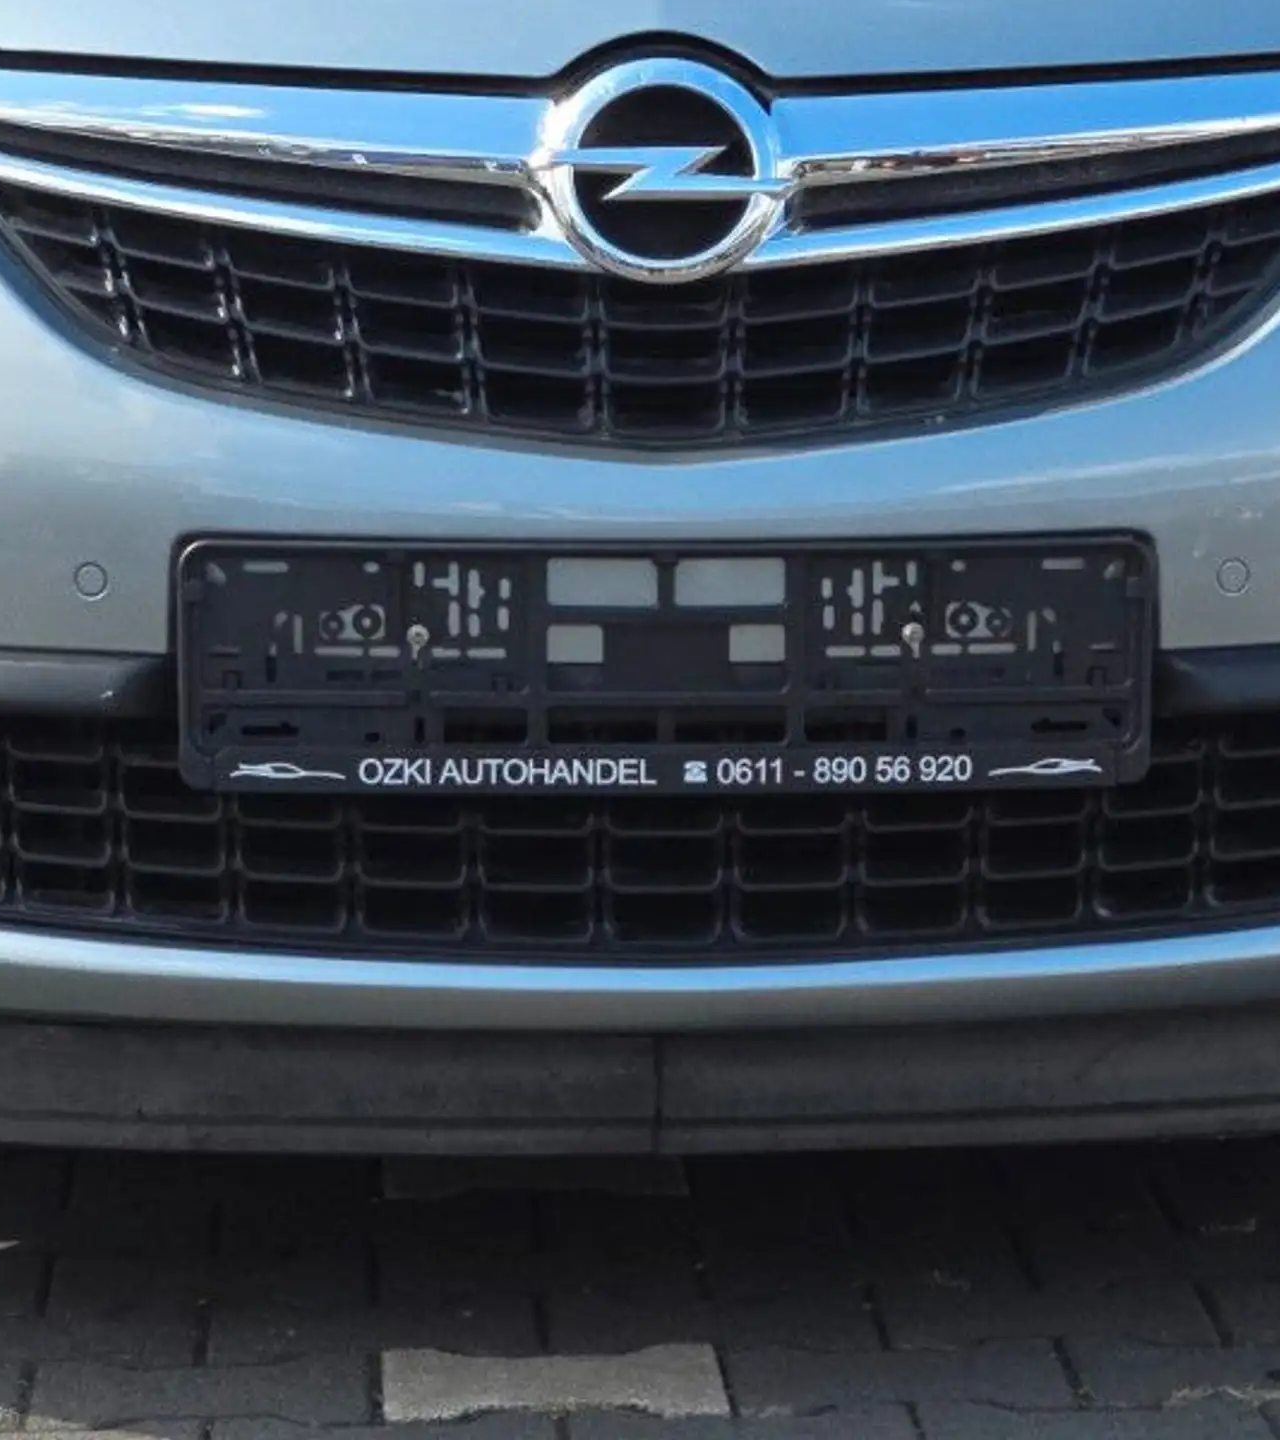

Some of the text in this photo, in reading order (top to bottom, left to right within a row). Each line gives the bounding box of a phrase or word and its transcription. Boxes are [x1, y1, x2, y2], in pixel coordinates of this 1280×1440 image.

[358, 757, 431, 785] OZKI
[438, 758, 658, 785] AUTOHANDEL
[716, 758, 783, 785] 0611
[813, 756, 867, 784] 890
[875, 755, 911, 783] 56
[918, 754, 973, 782] 920
